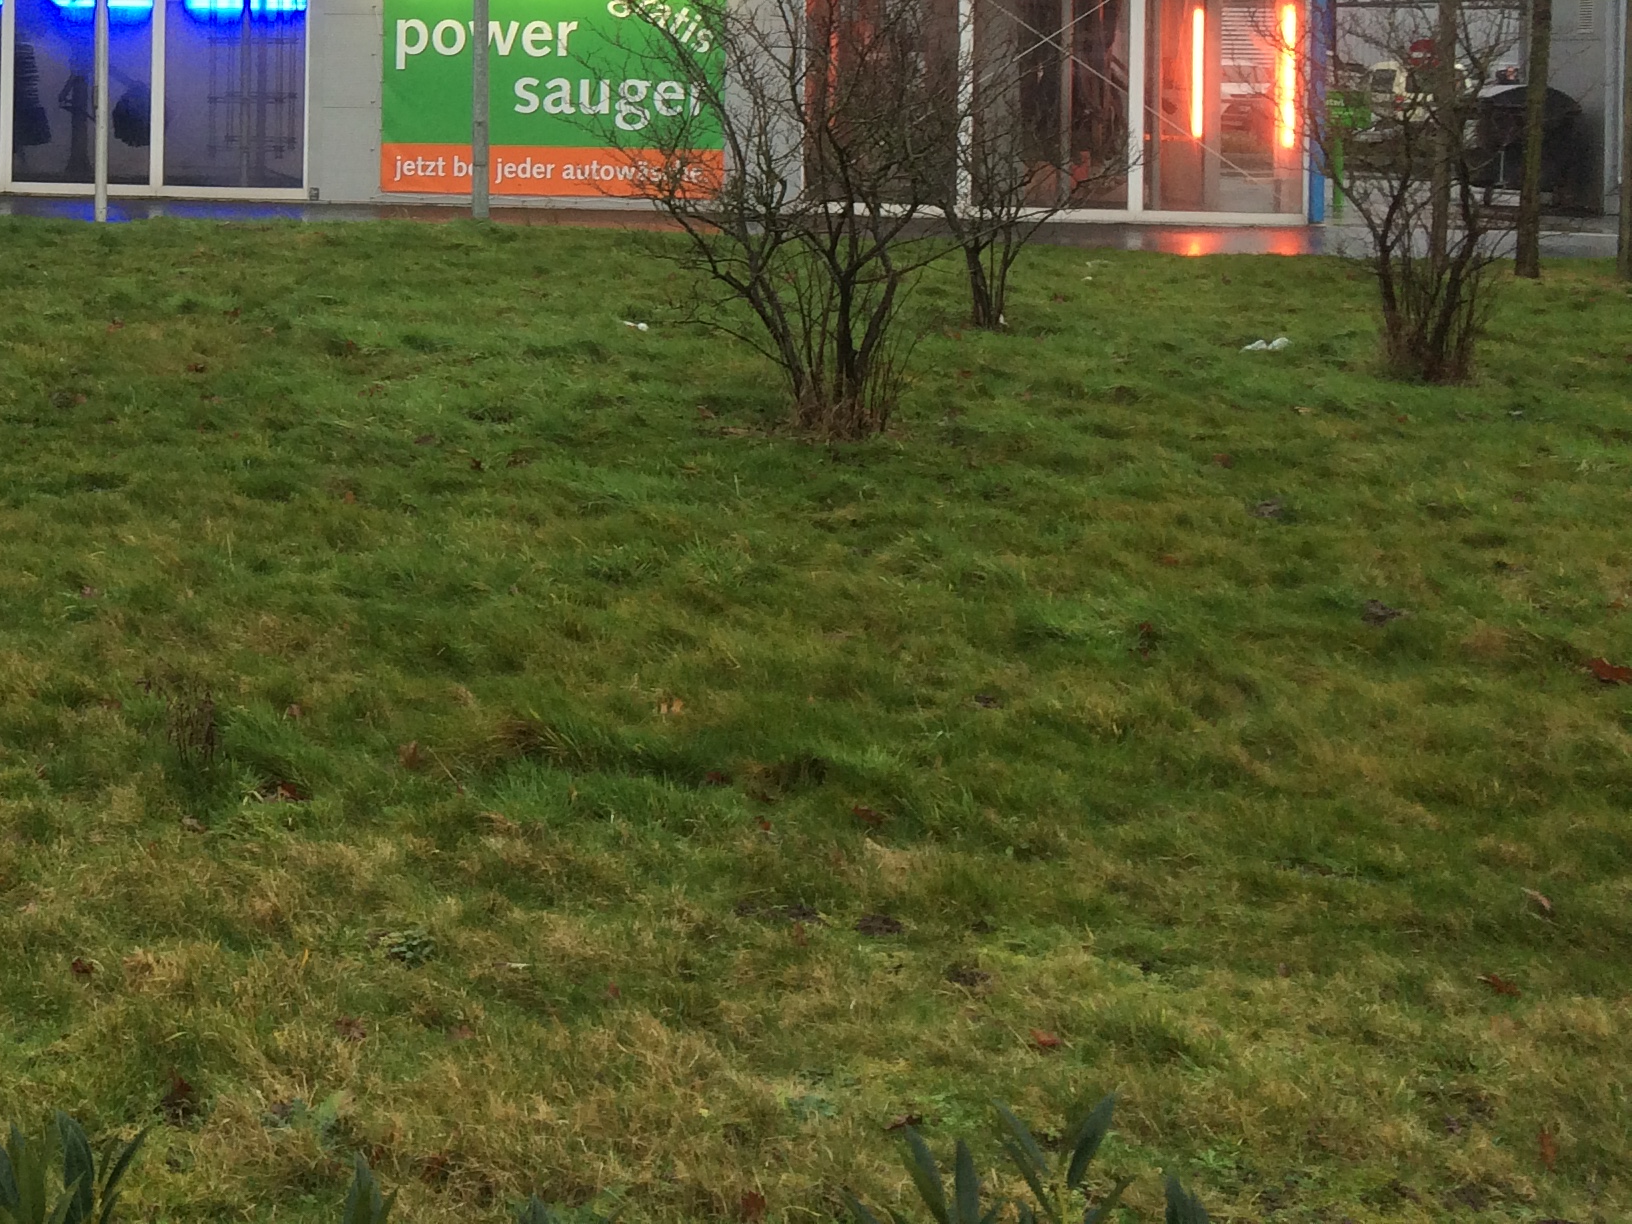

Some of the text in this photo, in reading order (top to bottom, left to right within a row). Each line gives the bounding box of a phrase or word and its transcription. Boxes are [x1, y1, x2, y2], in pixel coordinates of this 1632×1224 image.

[394, 16, 579, 71] power
[513, 75, 714, 132] sauger
[394, 155, 446, 182] jetzt
[494, 156, 556, 184] jeder
